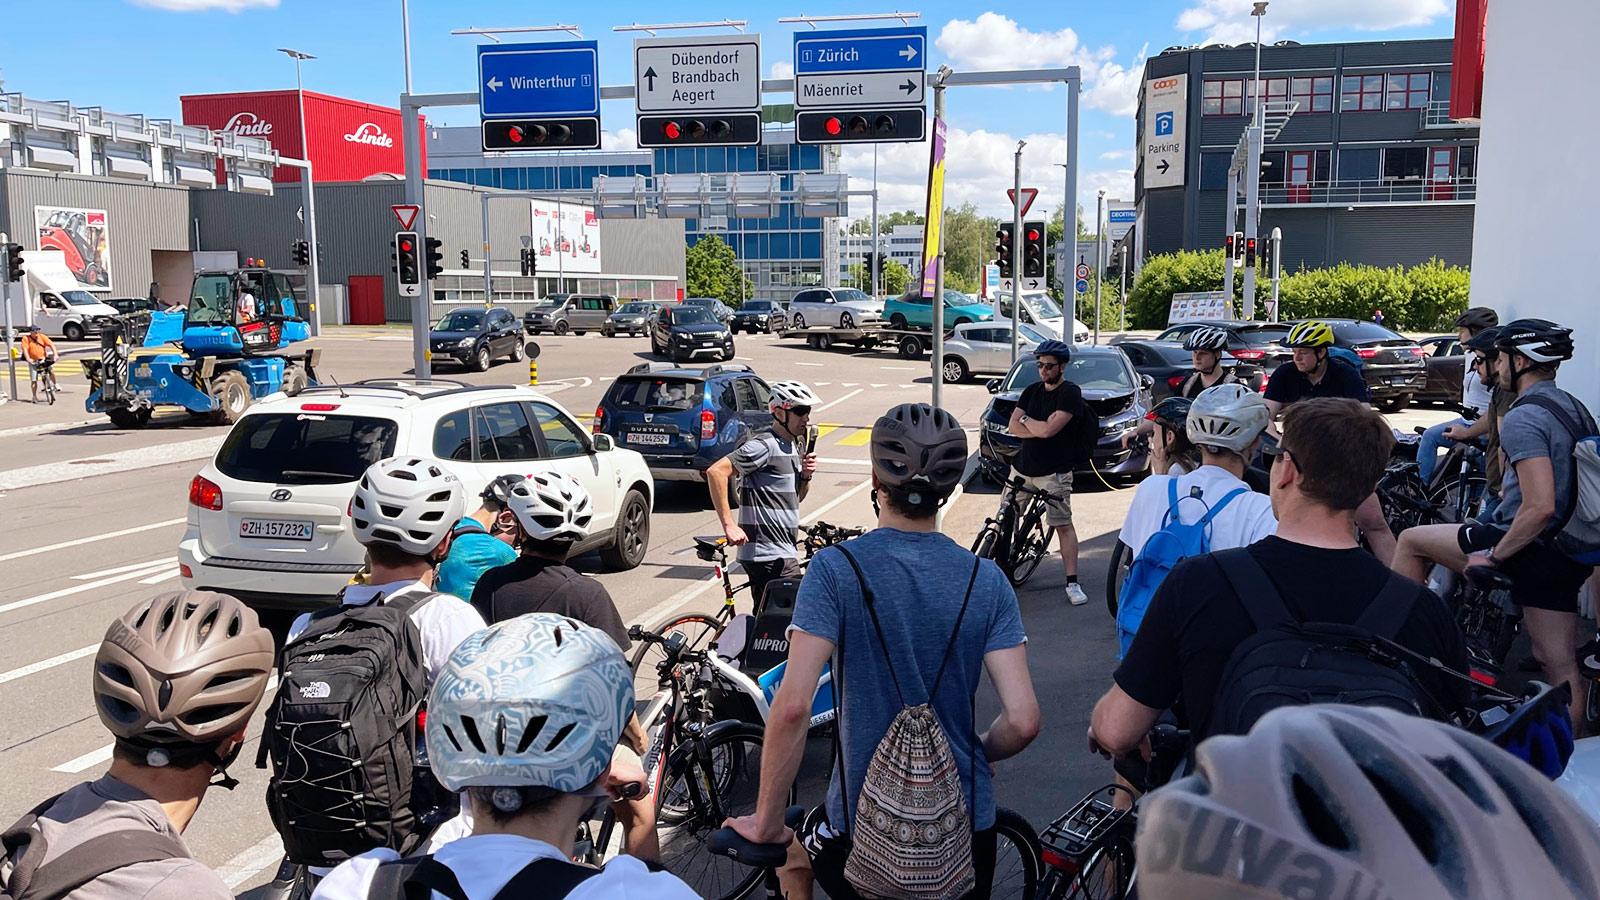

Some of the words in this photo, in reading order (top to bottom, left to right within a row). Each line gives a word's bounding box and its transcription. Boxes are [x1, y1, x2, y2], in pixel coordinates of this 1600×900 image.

[671, 50, 739, 66] Dübendorf
[817, 47, 859, 62] Zürich
[510, 74, 576, 90] Winterthur
[671, 68, 739, 84] Brandbach
[803, 82, 864, 97] Mäenriet
[1153, 78, 1178, 90] coop
[672, 89, 715, 104] Aegert
[214, 112, 272, 136] Linde
[344, 122, 393, 149] Linde
[1148, 143, 1180, 154] Parking
